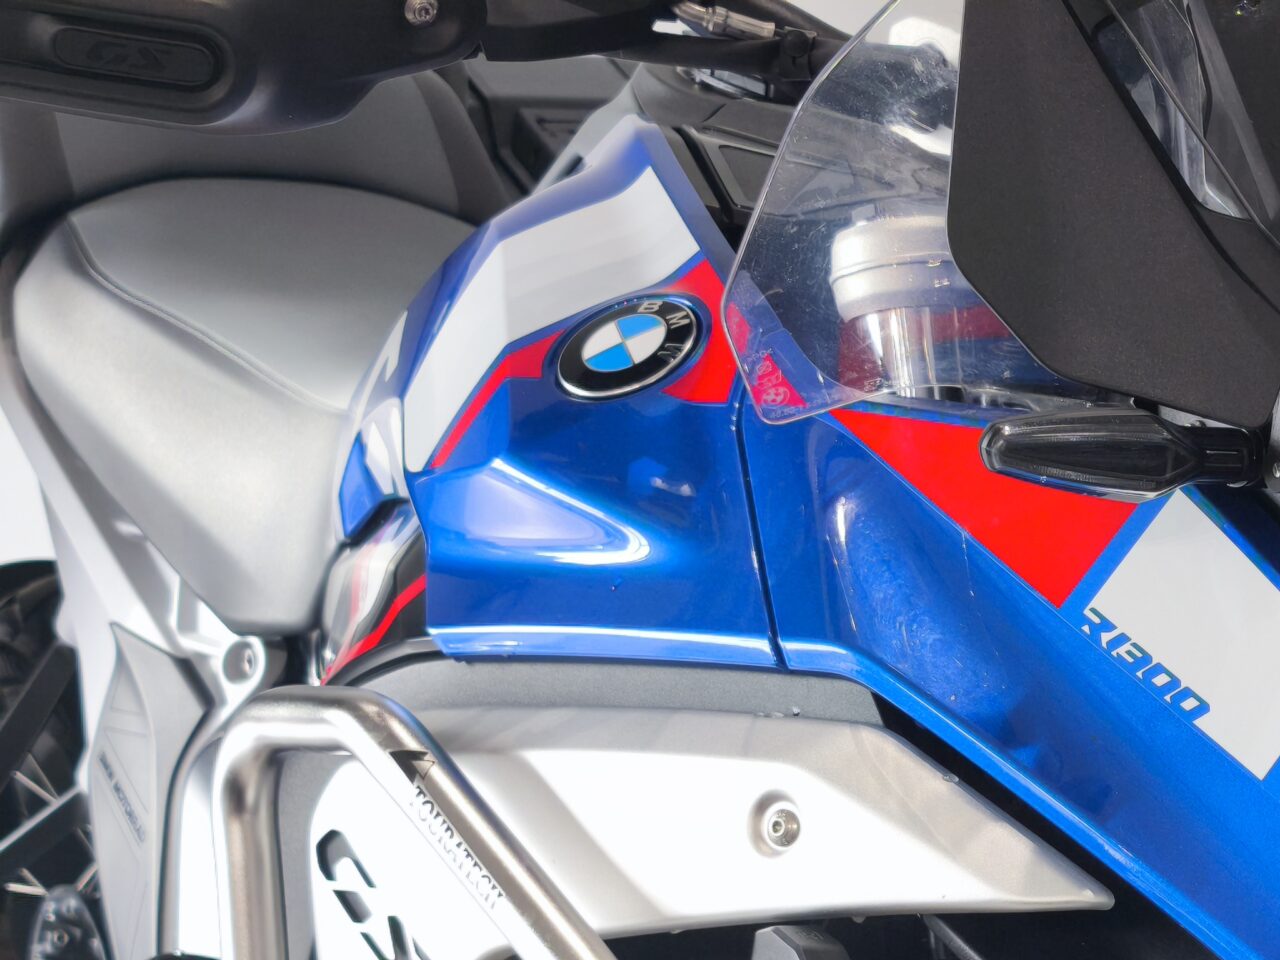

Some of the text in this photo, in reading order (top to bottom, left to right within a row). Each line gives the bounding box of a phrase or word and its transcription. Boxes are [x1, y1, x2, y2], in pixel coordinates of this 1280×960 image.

[637, 300, 692, 362] BMW
[1079, 606, 1211, 723] R1300
[409, 784, 504, 910] TOURATECH
